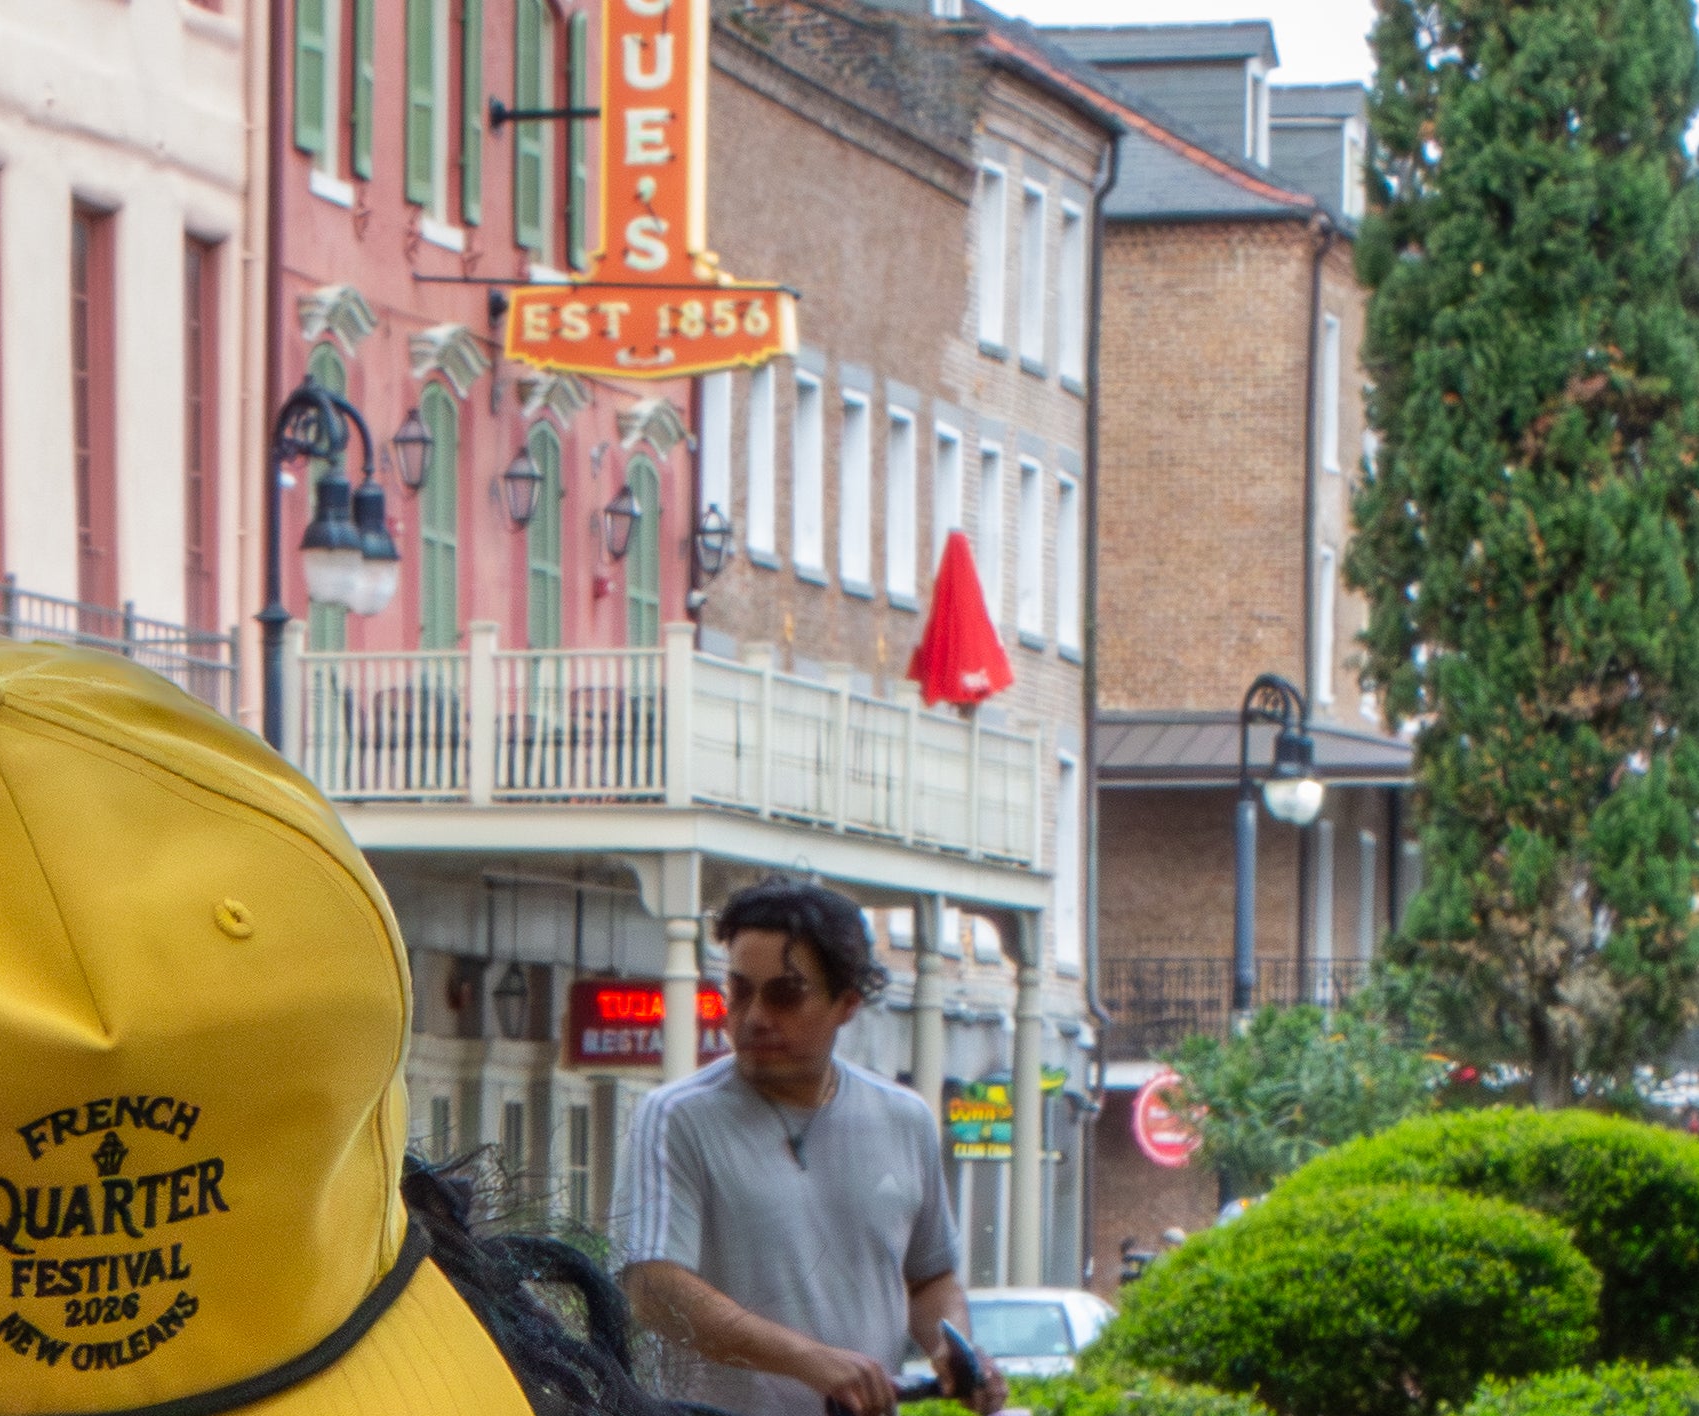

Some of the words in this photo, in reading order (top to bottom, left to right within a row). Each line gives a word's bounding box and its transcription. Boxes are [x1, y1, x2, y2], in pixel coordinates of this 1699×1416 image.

[522, 303, 630, 342] EST
[657, 298, 771, 339] 1856
[17, 1096, 200, 1160] FRENCH
[10, 1242, 192, 1298] FESTIVAL
[65, 1292, 140, 1328] 2026
[71, 1290, 199, 1371] ORLEANS
